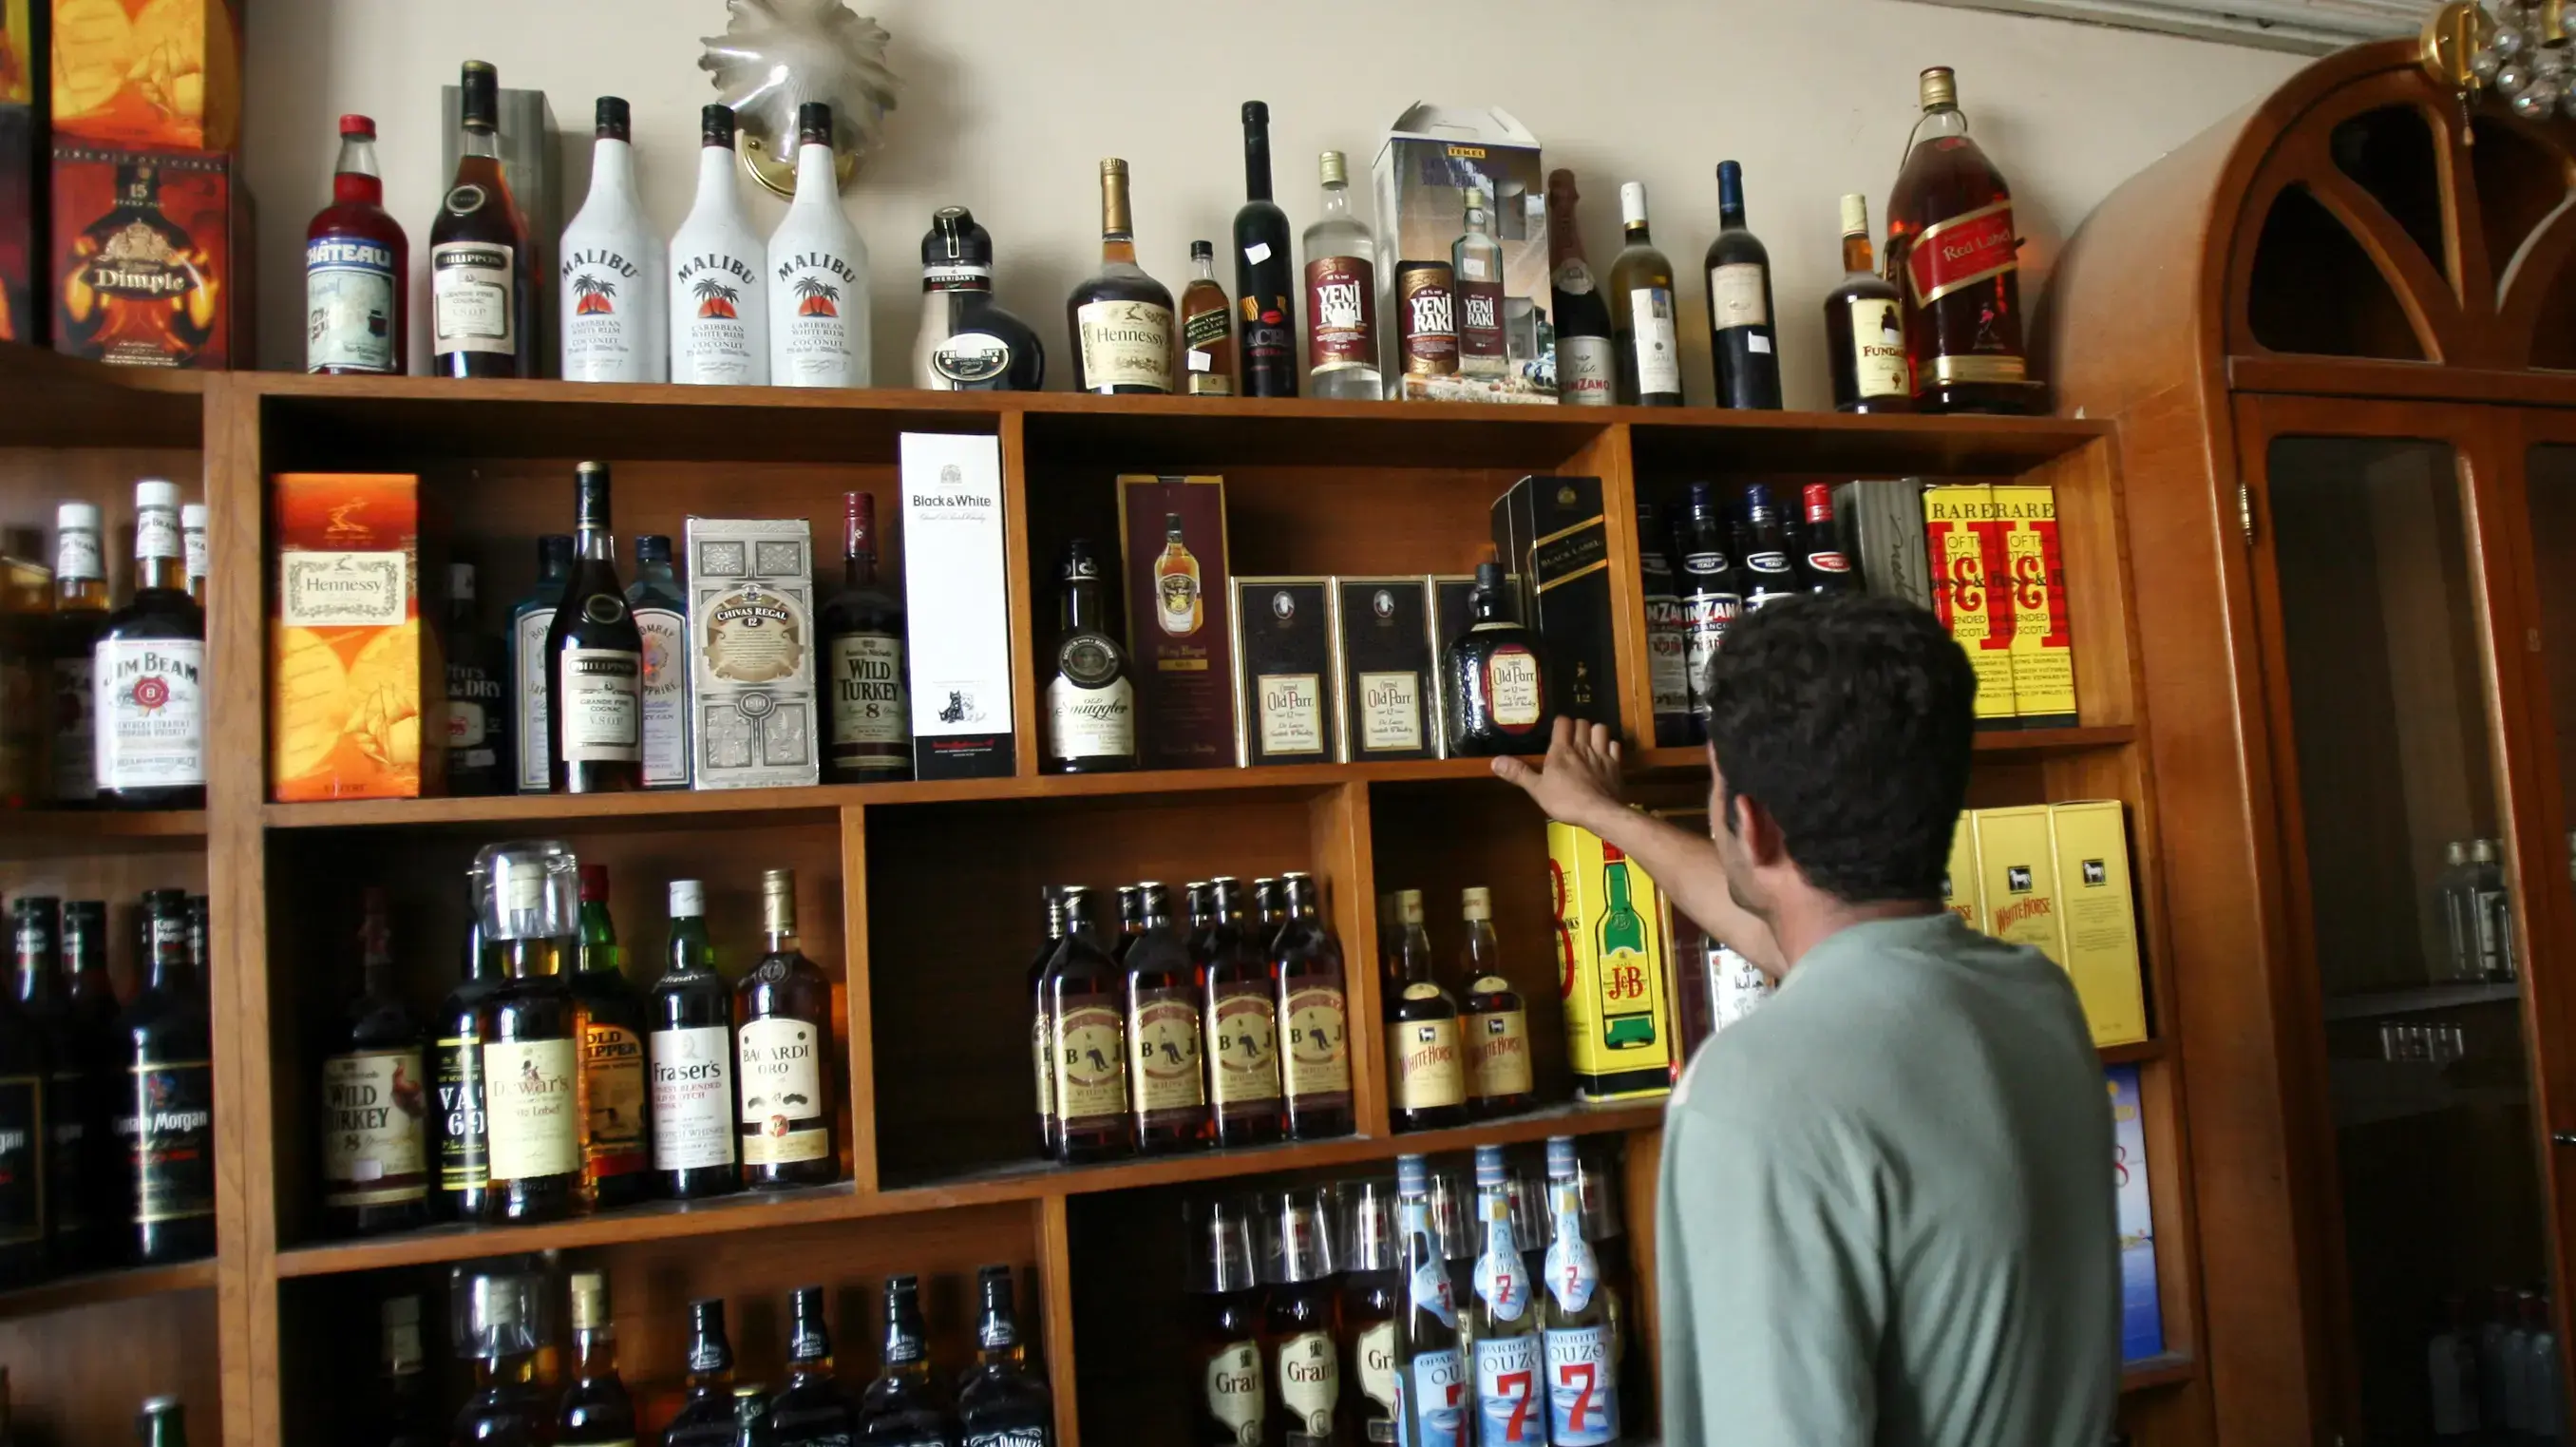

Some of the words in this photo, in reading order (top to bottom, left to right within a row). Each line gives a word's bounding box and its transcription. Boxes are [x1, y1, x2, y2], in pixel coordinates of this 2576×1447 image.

[1942, 243, 1973, 261] Red
[1976, 228, 2011, 250] Label
[562, 249, 637, 280] MALIBU
[677, 253, 754, 285] MALIBU
[778, 252, 856, 283] MALIBU
[96, 268, 184, 293] Dimple
[691, 324, 745, 333] CARIBBEAN
[791, 322, 844, 331] CARIBBEAN
[693, 340, 745, 350] COCONUT
[792, 338, 843, 348] COCONUT
[1096, 327, 1166, 348] Hennessy
[941, 348, 1000, 359] SHAN'S
[1932, 503, 1995, 519] RARE
[1995, 502, 2055, 519] RARE
[1541, 551, 1570, 567] BLACK
[306, 577, 383, 594] Hennessy
[717, 606, 752, 621] CHIVAS
[754, 606, 787, 620] REGAL
[1684, 600, 1736, 623] INZAN
[1953, 615, 1987, 625] ENDED
[2015, 613, 2048, 622] ENDED
[747, 618, 758, 627] 12
[143, 652, 199, 686] BEAM
[847, 658, 891, 680] WILD
[1493, 667, 1512, 686] Old
[838, 679, 899, 702] TURKEY
[1368, 689, 1387, 708] Old
[865, 703, 881, 719] 8
[1267, 692, 1286, 711] Old
[1997, 904, 2023, 936] WHITE
[2023, 898, 2052, 920] HORSE
[1609, 966, 1645, 1000] J&B
[1220, 1035, 1231, 1051] B
[1263, 1031, 1272, 1048] J
[1291, 1028, 1302, 1043] B
[1334, 1025, 1342, 1041] J
[588, 1044, 637, 1057] IPPER
[1065, 1049, 1078, 1065] B
[1142, 1042, 1153, 1057] B
[654, 1059, 722, 1082] Fraser's
[758, 1062, 789, 1075] ORO
[1401, 1048, 1429, 1081] WHITE
[681, 1082, 722, 1092] BLENDED
[153, 1111, 208, 1134] Morgan
[447, 1112, 485, 1135] 69
[1496, 1275, 1511, 1304] 7
[1566, 1266, 1579, 1295] 7
[1549, 1341, 1606, 1362] OUZO
[1497, 1370, 1532, 1442] 7
[1560, 1362, 1596, 1432] 7
